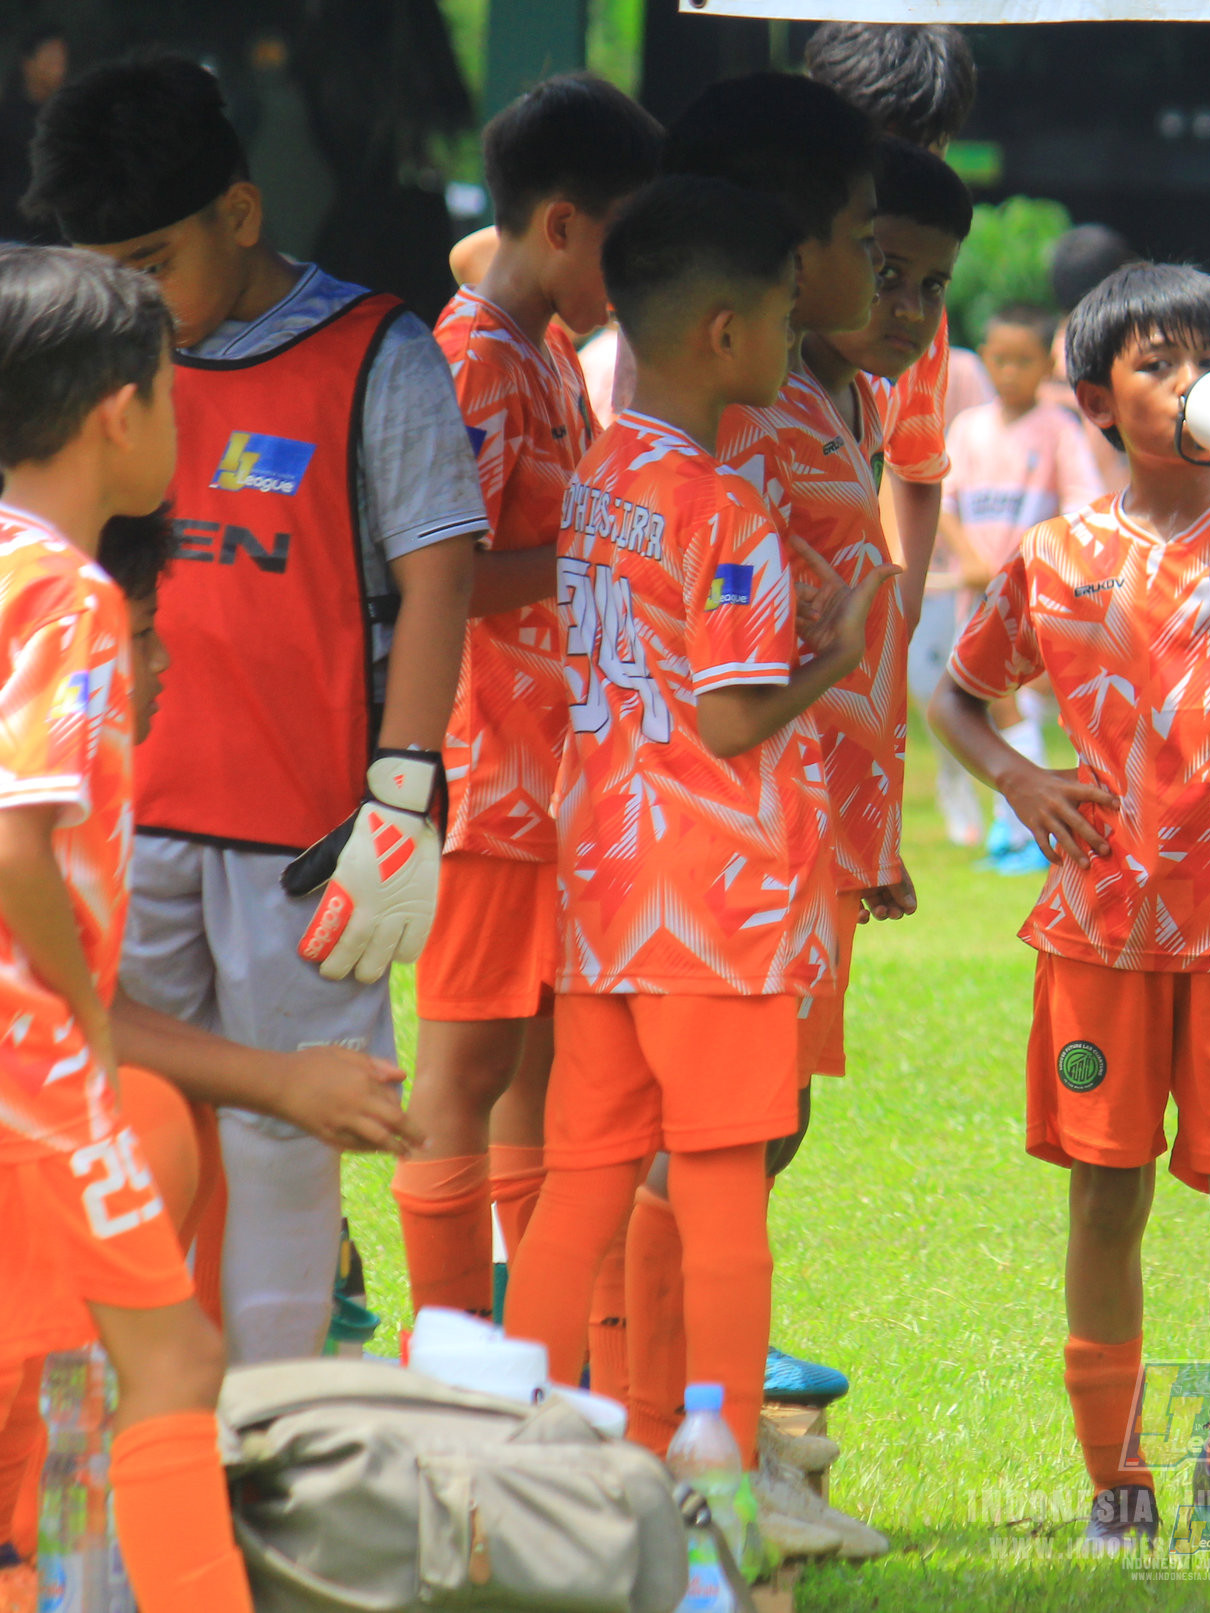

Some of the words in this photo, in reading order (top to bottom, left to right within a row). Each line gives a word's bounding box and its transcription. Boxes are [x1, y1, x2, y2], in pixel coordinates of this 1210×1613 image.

[236, 472, 294, 493] League
[1074, 578, 1125, 598] ERUKOV
[304, 897, 345, 960] adidas
